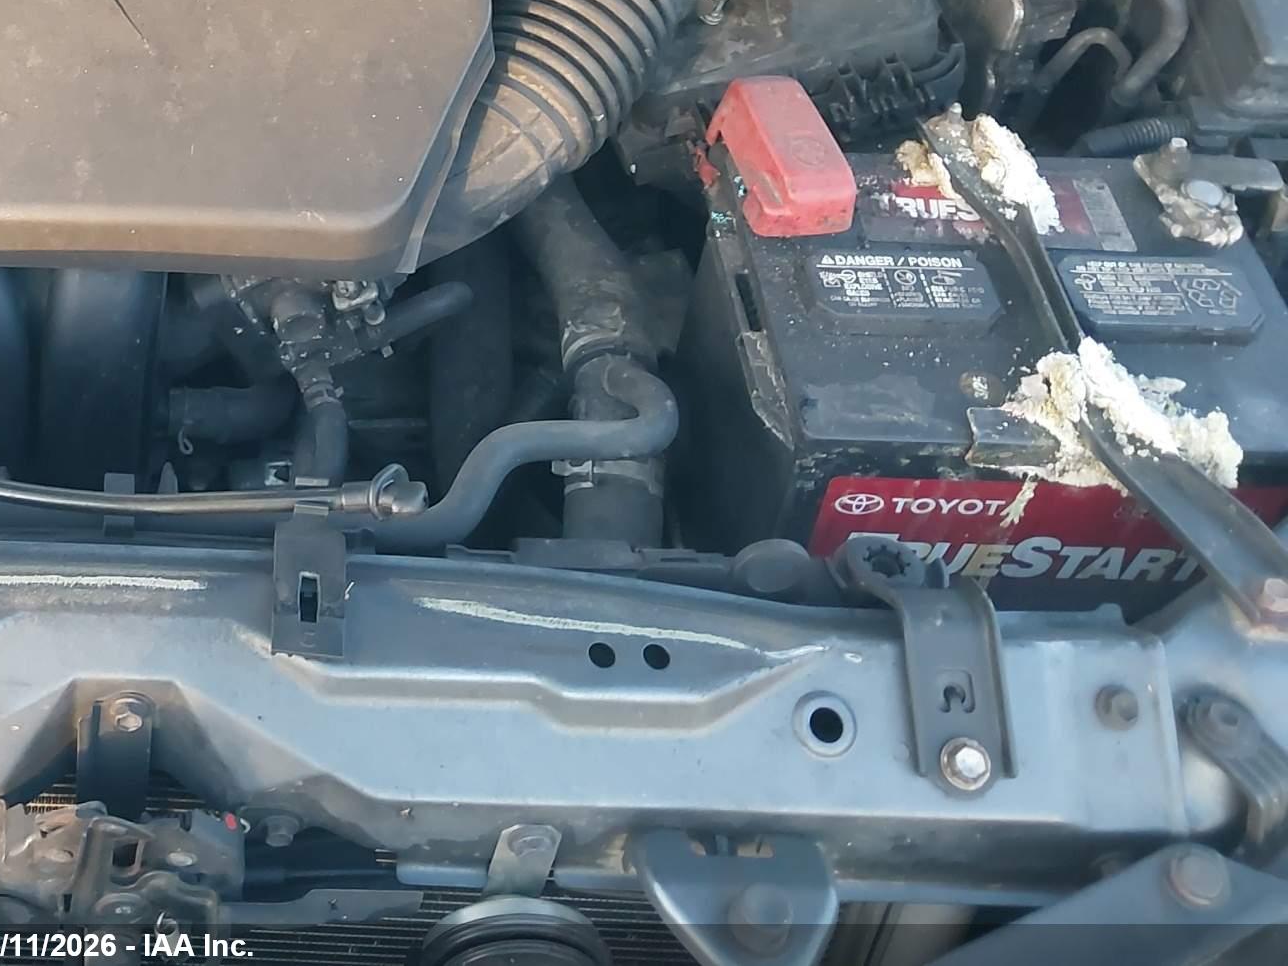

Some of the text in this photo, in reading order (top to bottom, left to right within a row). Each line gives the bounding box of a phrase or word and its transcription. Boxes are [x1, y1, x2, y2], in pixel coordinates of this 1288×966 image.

[834, 255, 963, 268] DANGER / POISON
[891, 497, 1015, 516] TOYOT
[847, 532, 1200, 581] UESTART
